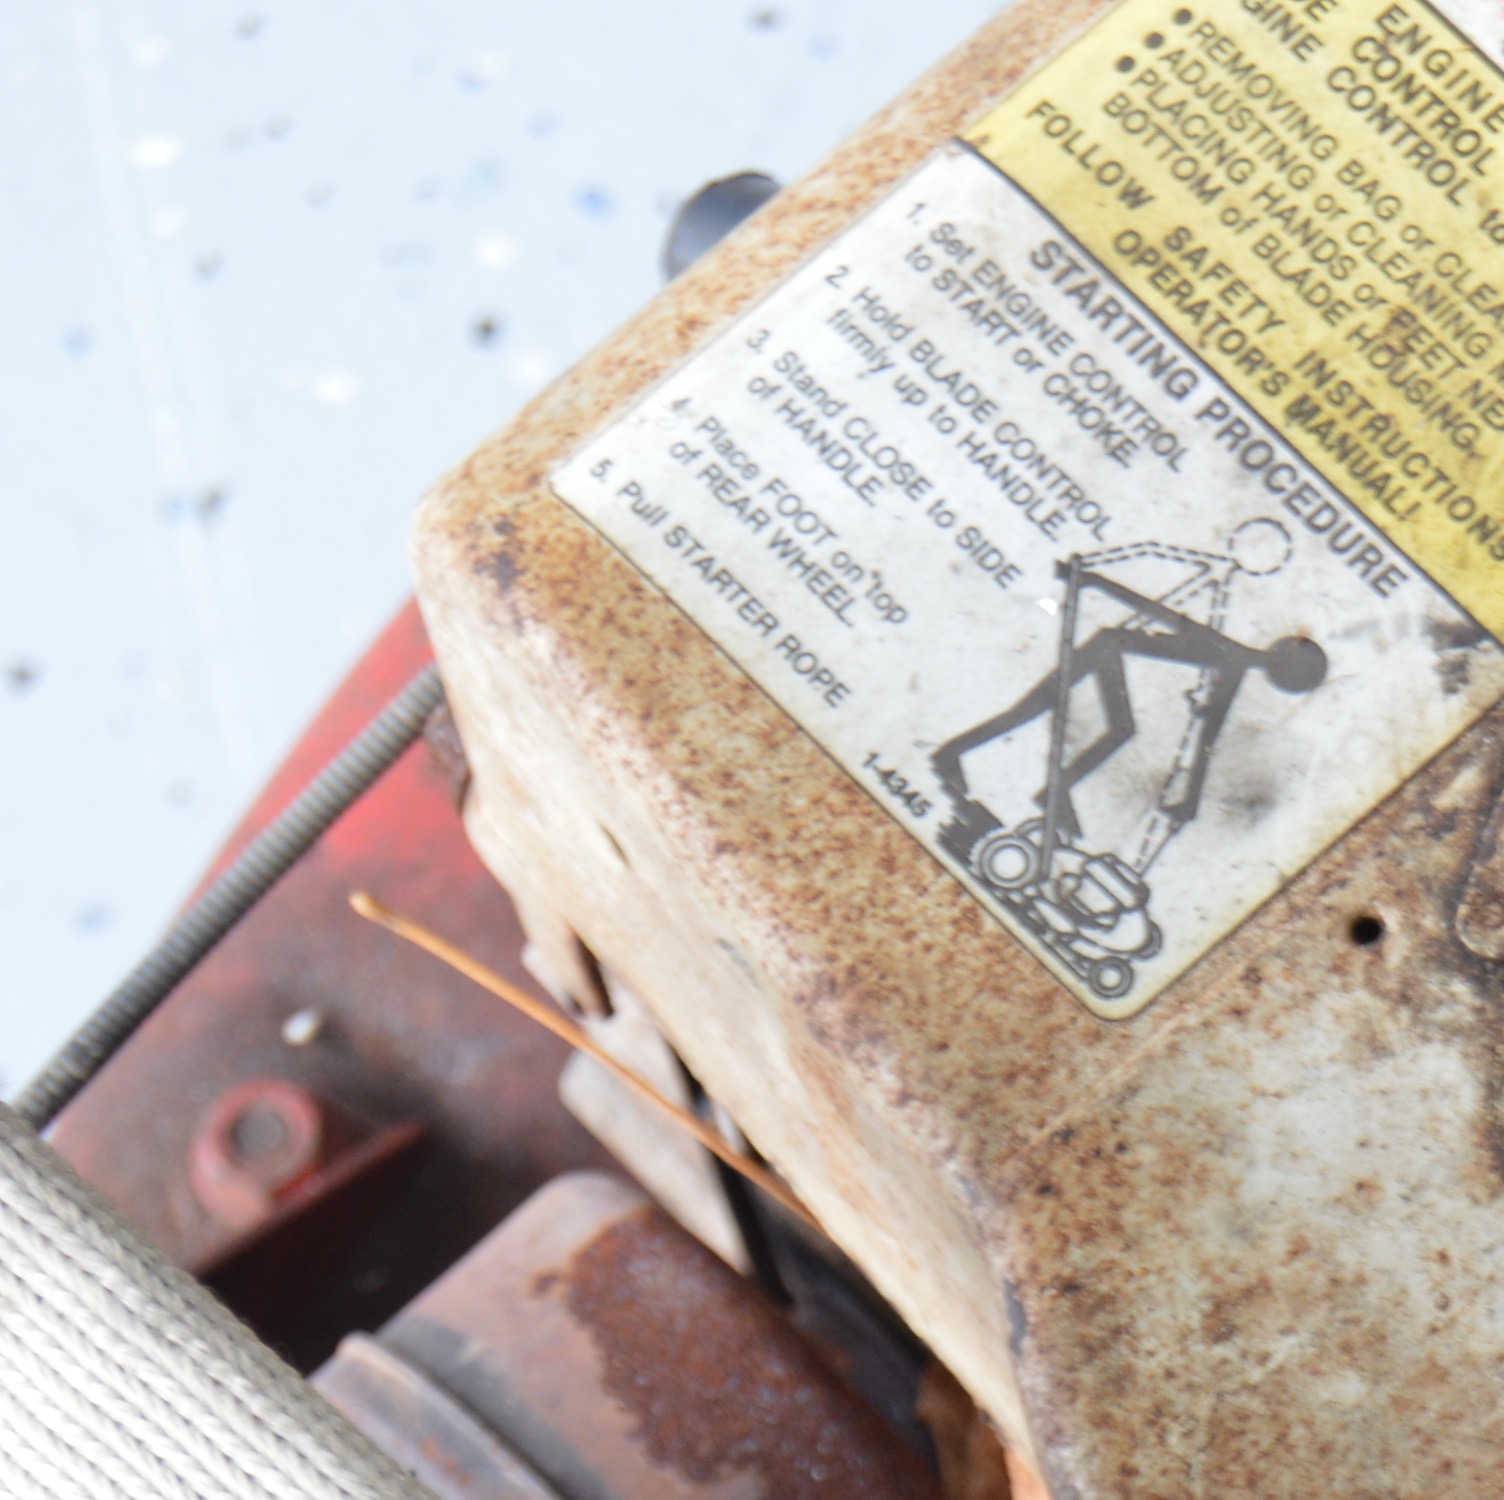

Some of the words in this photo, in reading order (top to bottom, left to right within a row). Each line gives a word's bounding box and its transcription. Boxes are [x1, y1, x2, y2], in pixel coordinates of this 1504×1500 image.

[1025, 99, 1156, 211] FOLLOW
[1163, 224, 1288, 335] SAFETY
[1101, 91, 1226, 206] BOTTOM
[1219, 205, 1260, 236] of
[1250, 232, 1355, 328] BLADE
[1129, 67, 1257, 187] PLACING
[1250, 181, 1358, 282] HANDS
[1352, 282, 1390, 311] or
[1382, 305, 1469, 380] FEET
[1157, 47, 1317, 193] ADJUSTING
[1313, 192, 1350, 221] or
[1346, 220, 1495, 361] CLEANING
[1189, 19, 1340, 163] REMOVING
[1335, 157, 1403, 223] BAG
[1400, 223, 1437, 252] or
[1325, 64, 1471, 208] CONTROL
[1350, 34, 1496, 178] CONTROL
[825, 307, 896, 375] firmly
[893, 374, 928, 407] up
[927, 404, 958, 436] to
[955, 430, 1067, 543] HANDLE.
[851, 285, 916, 343] Hold
[908, 338, 1000, 425] BLADE
[993, 420, 1113, 543] CONTROL
[903, 243, 933, 273] to
[931, 267, 1022, 346] START
[1012, 347, 1045, 374] or
[929, 221, 976, 264] Set
[971, 258, 1076, 357] ENGINE
[1069, 351, 1189, 475] CONTROL
[1028, 239, 1200, 403] STARTING
[1193, 396, 1409, 600] PROCEDURE
[1113, 228, 1291, 398] OPERATOR'S
[1284, 392, 1423, 523] MANUAL!
[668, 440, 704, 466] of
[696, 462, 772, 534] REAR
[767, 528, 856, 629] WHEEL.
[694, 415, 761, 481] Place
[760, 476, 840, 546] FOOT
[830, 550, 866, 583] on
[865, 573, 910, 625] top
[747, 375, 783, 401] of
[774, 397, 885, 508] HANDLE.
[772, 350, 850, 419] Stand
[843, 415, 934, 503] CLOSE
[926, 498, 957, 530] to
[955, 525, 1024, 590] SIDE
[616, 479, 670, 527] Pull
[663, 524, 781, 638] STARTER
[774, 633, 852, 709] ROPE
[862, 751, 933, 818] 1-4345
